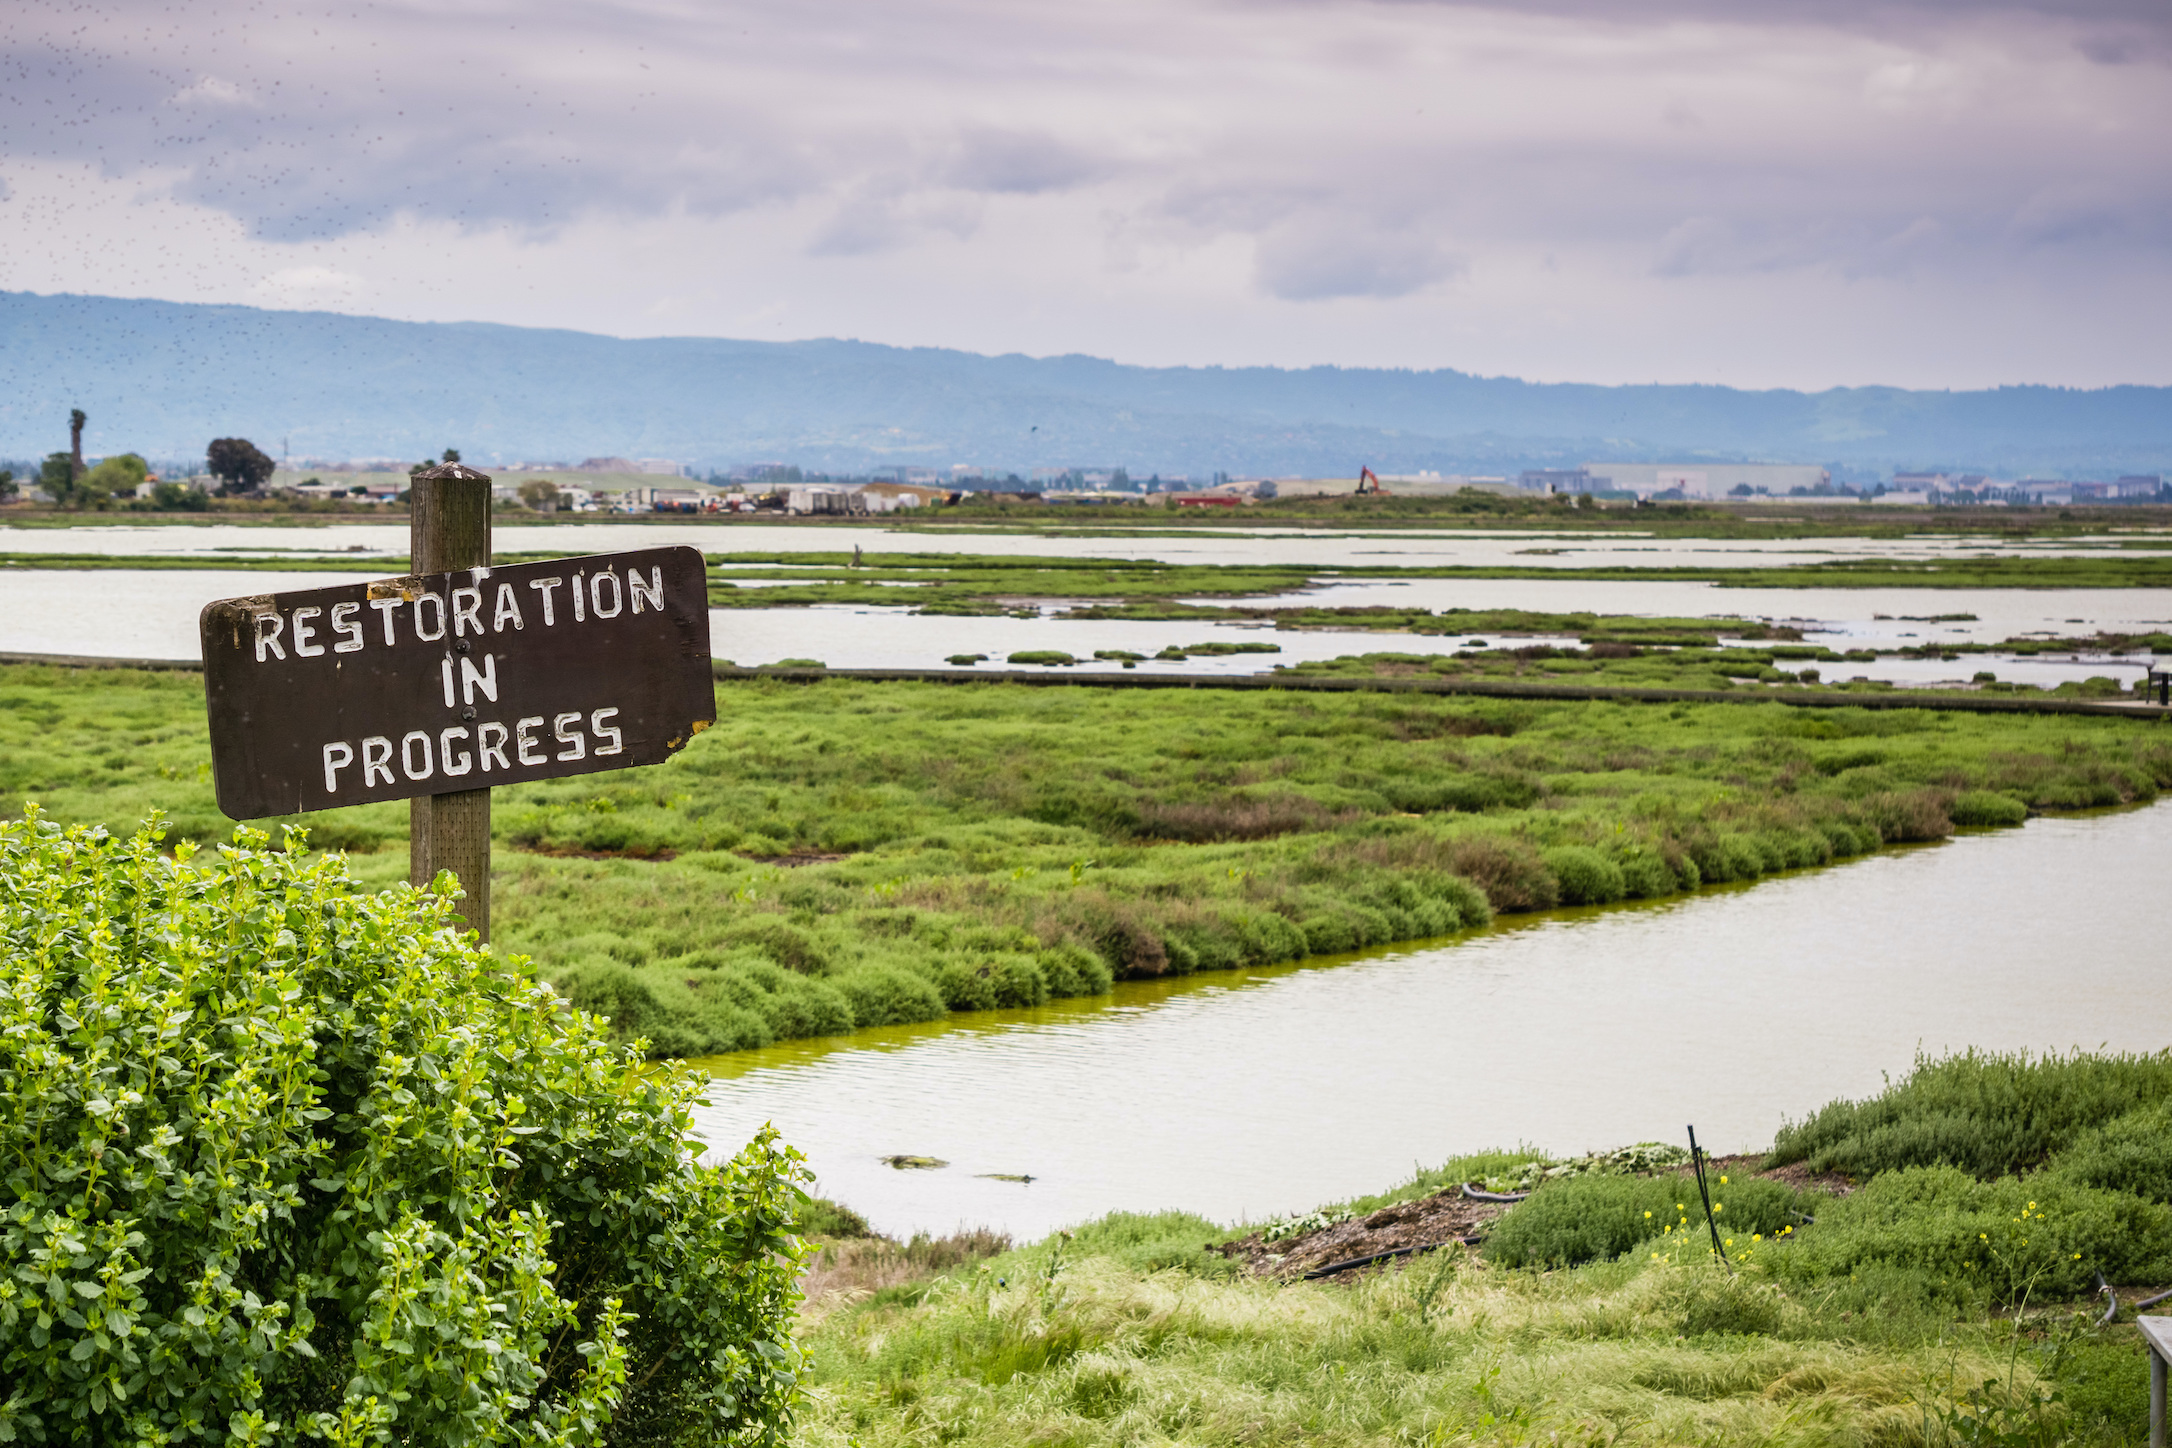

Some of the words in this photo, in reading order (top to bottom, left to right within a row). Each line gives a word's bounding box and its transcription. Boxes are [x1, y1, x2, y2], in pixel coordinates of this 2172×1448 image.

[254, 565, 666, 663] RESTORATION
[442, 653, 498, 707] IN
[322, 707, 624, 793] PROGRESS
